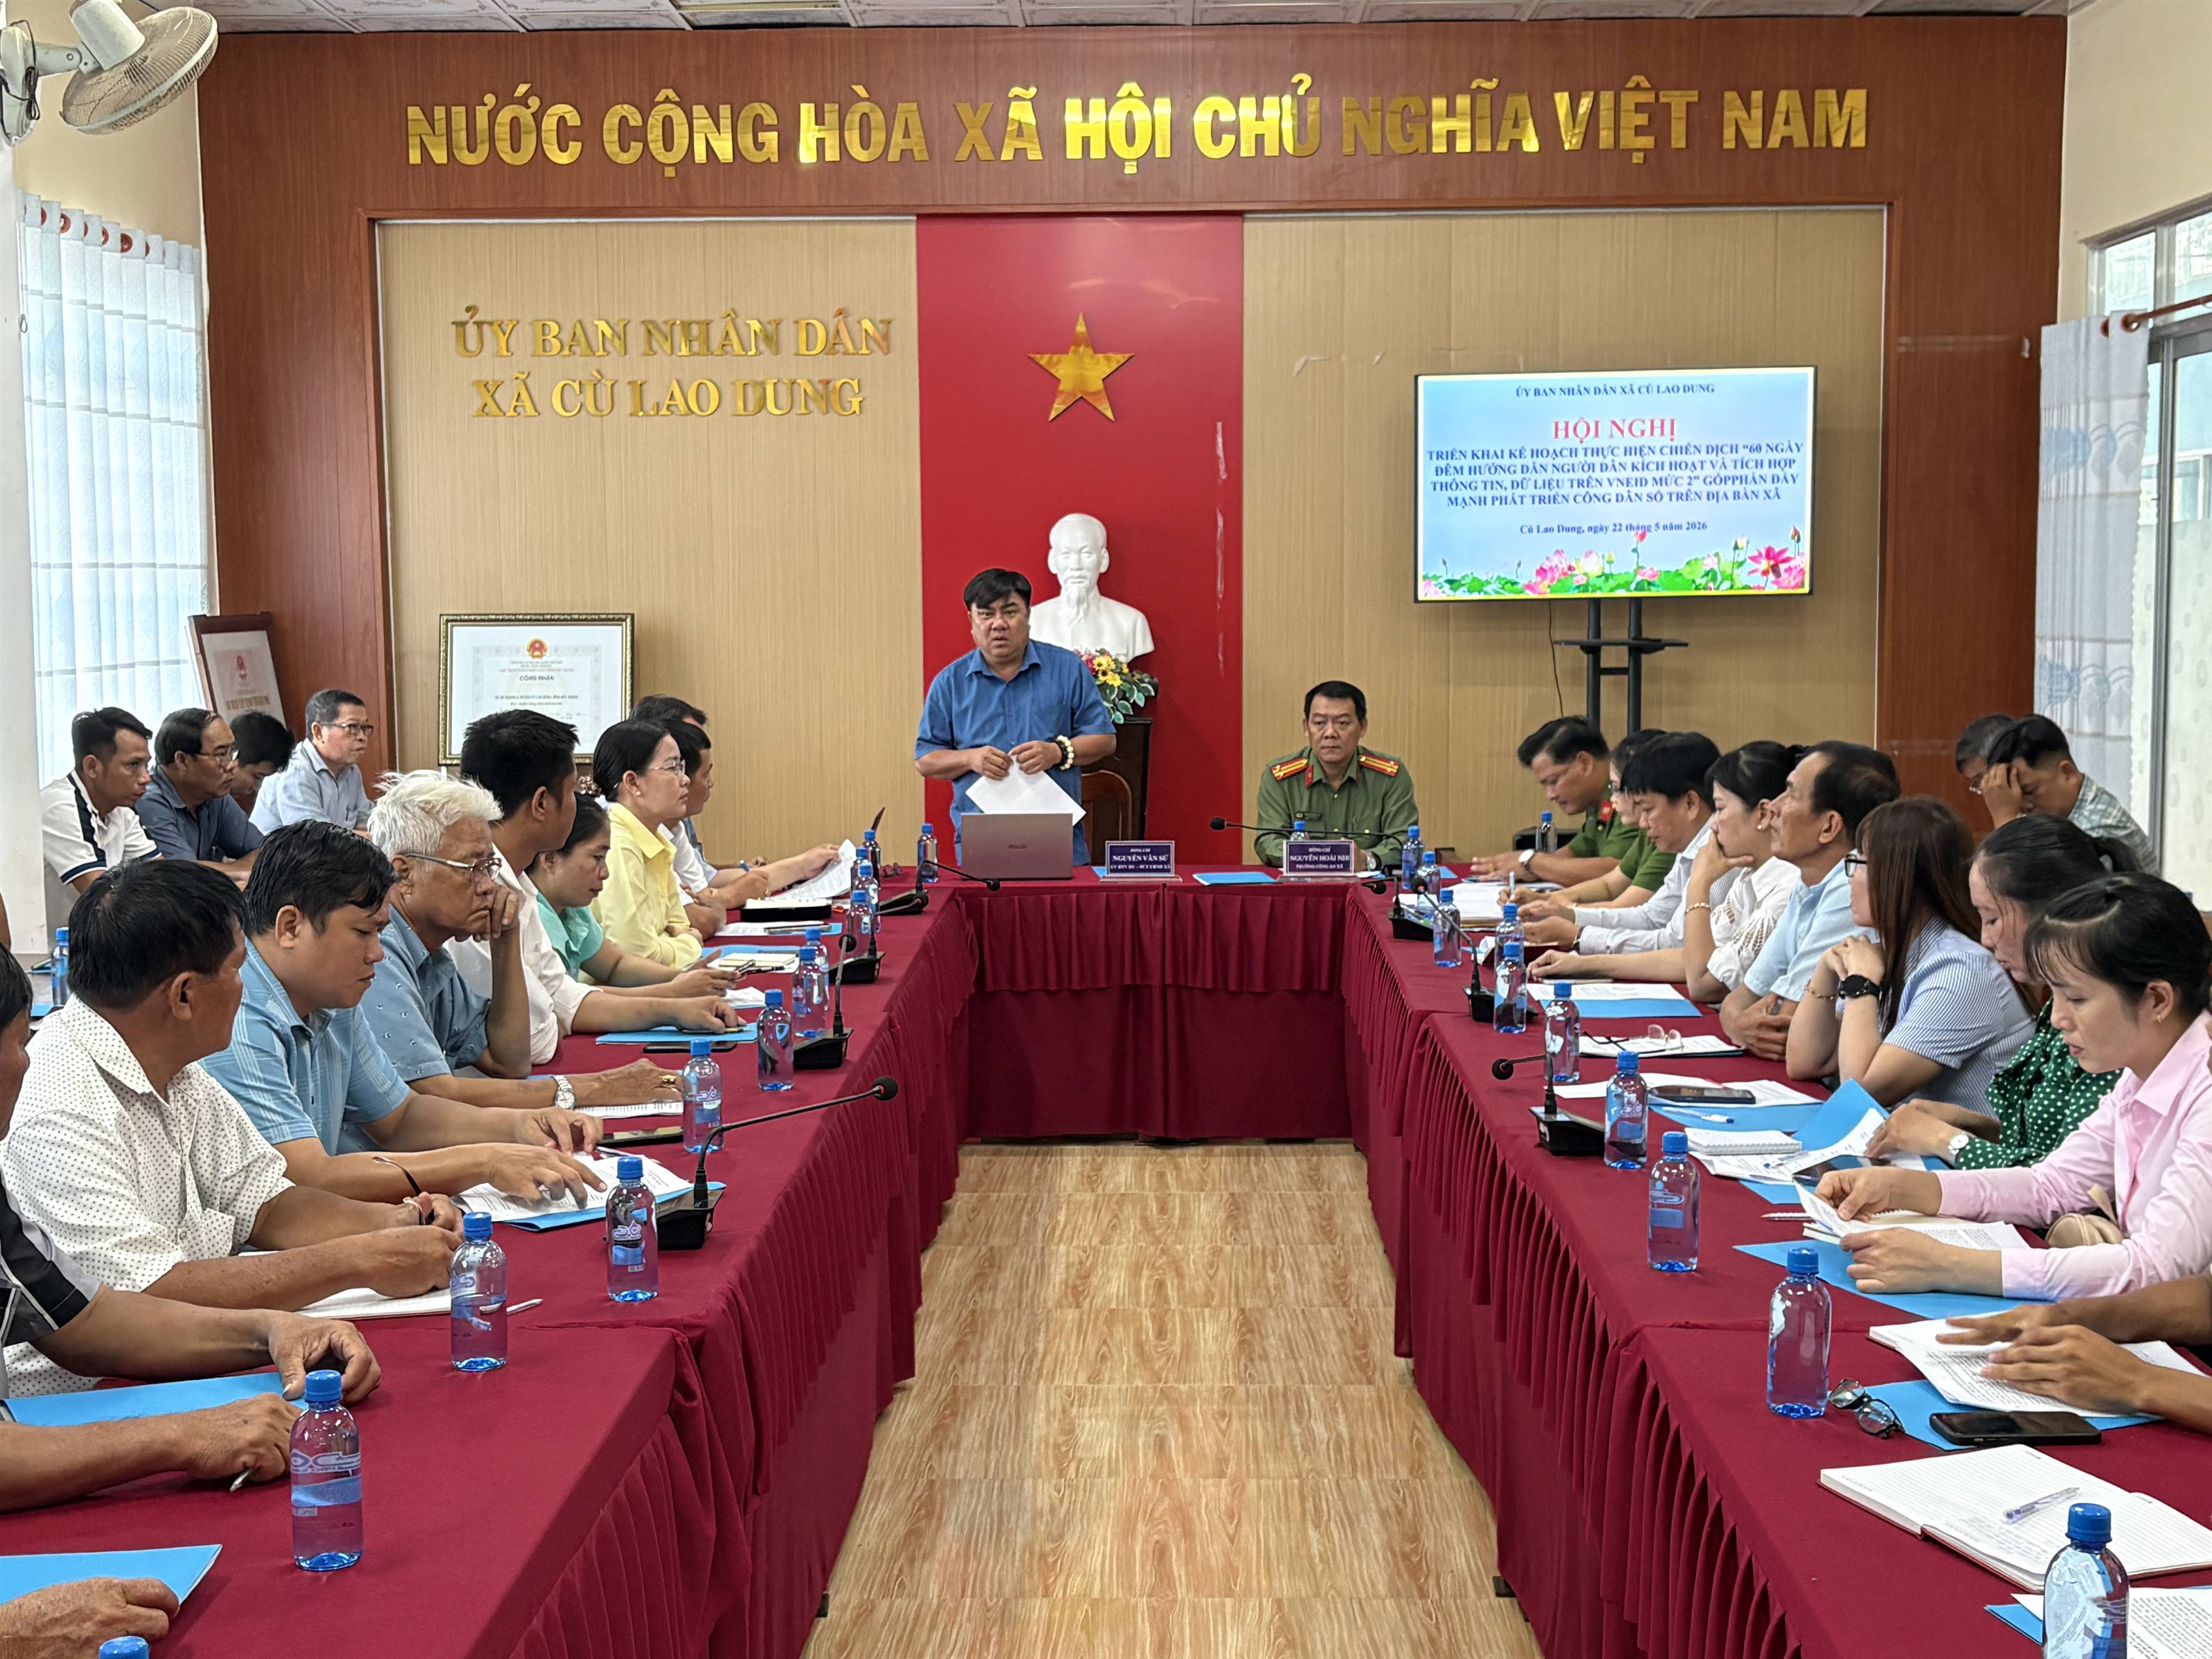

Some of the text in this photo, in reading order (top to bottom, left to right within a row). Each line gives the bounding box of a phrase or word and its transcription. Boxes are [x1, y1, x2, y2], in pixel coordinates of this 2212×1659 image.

[408, 73, 1867, 177] NƯỚC CỘNG HÒA XÃ HỘI CHỦ NGHĨA VIỆT NAM
[451, 305, 893, 358] ỦY BAN NHÂN DÂN
[471, 372, 864, 418] XÃ CÙ LAO DUNG
[1516, 383, 1715, 397] ỦY BAN NHÂN DÂN XÃ CÙ LAO DUNG
[1553, 416, 1677, 444] HỘI NGHỊ
[1427, 448, 1467, 461] TRIỂN
[1471, 449, 1505, 460] KHAI
[1509, 446, 1527, 460] KẾ
[1530, 447, 1578, 461] HOẠCH
[1582, 446, 1621, 460] THỰC
[1623, 444, 1656, 458] HIỆN
[1660, 442, 1702, 456] CHIẾN
[1705, 443, 1739, 457] DỊCH
[1765, 440, 1804, 453] NGÀY
[1434, 463, 1464, 476] ĐÊM
[1468, 463, 1517, 476] HƯỚNG
[1552, 460, 1596, 474] NGƯỜI
[1600, 458, 1627, 473] DÂN
[1631, 457, 1665, 472] KÍCH
[1668, 460, 1707, 473] HOẠT
[1710, 457, 1728, 470] VÀ
[1731, 456, 1764, 470] TÍCH
[1768, 458, 1796, 471] HỢP
[1431, 478, 1478, 491] THÔNG
[1481, 480, 1507, 491] TIN,
[1510, 477, 1531, 490] DỮ
[1534, 478, 1565, 491] LIỆU
[1568, 475, 1603, 489] TRÊN
[1607, 477, 1648, 488] VNEID
[1652, 473, 1684, 487] MỨC
[1447, 496, 1488, 509] MẠNH
[1491, 493, 1527, 505] PHÁT
[1529, 493, 1570, 505] TRIỂN
[1573, 491, 1612, 504] CÔNG
[1615, 489, 1643, 503] DÂN
[1646, 489, 1664, 502] SỐ
[1667, 488, 1703, 502] TRÊN
[1732, 487, 1759, 501] BÀN
[1763, 487, 1782, 500] XÃ
[1520, 521, 1707, 535] Cù Lao Dung, ngày 22 tháng 5 năm 2026
